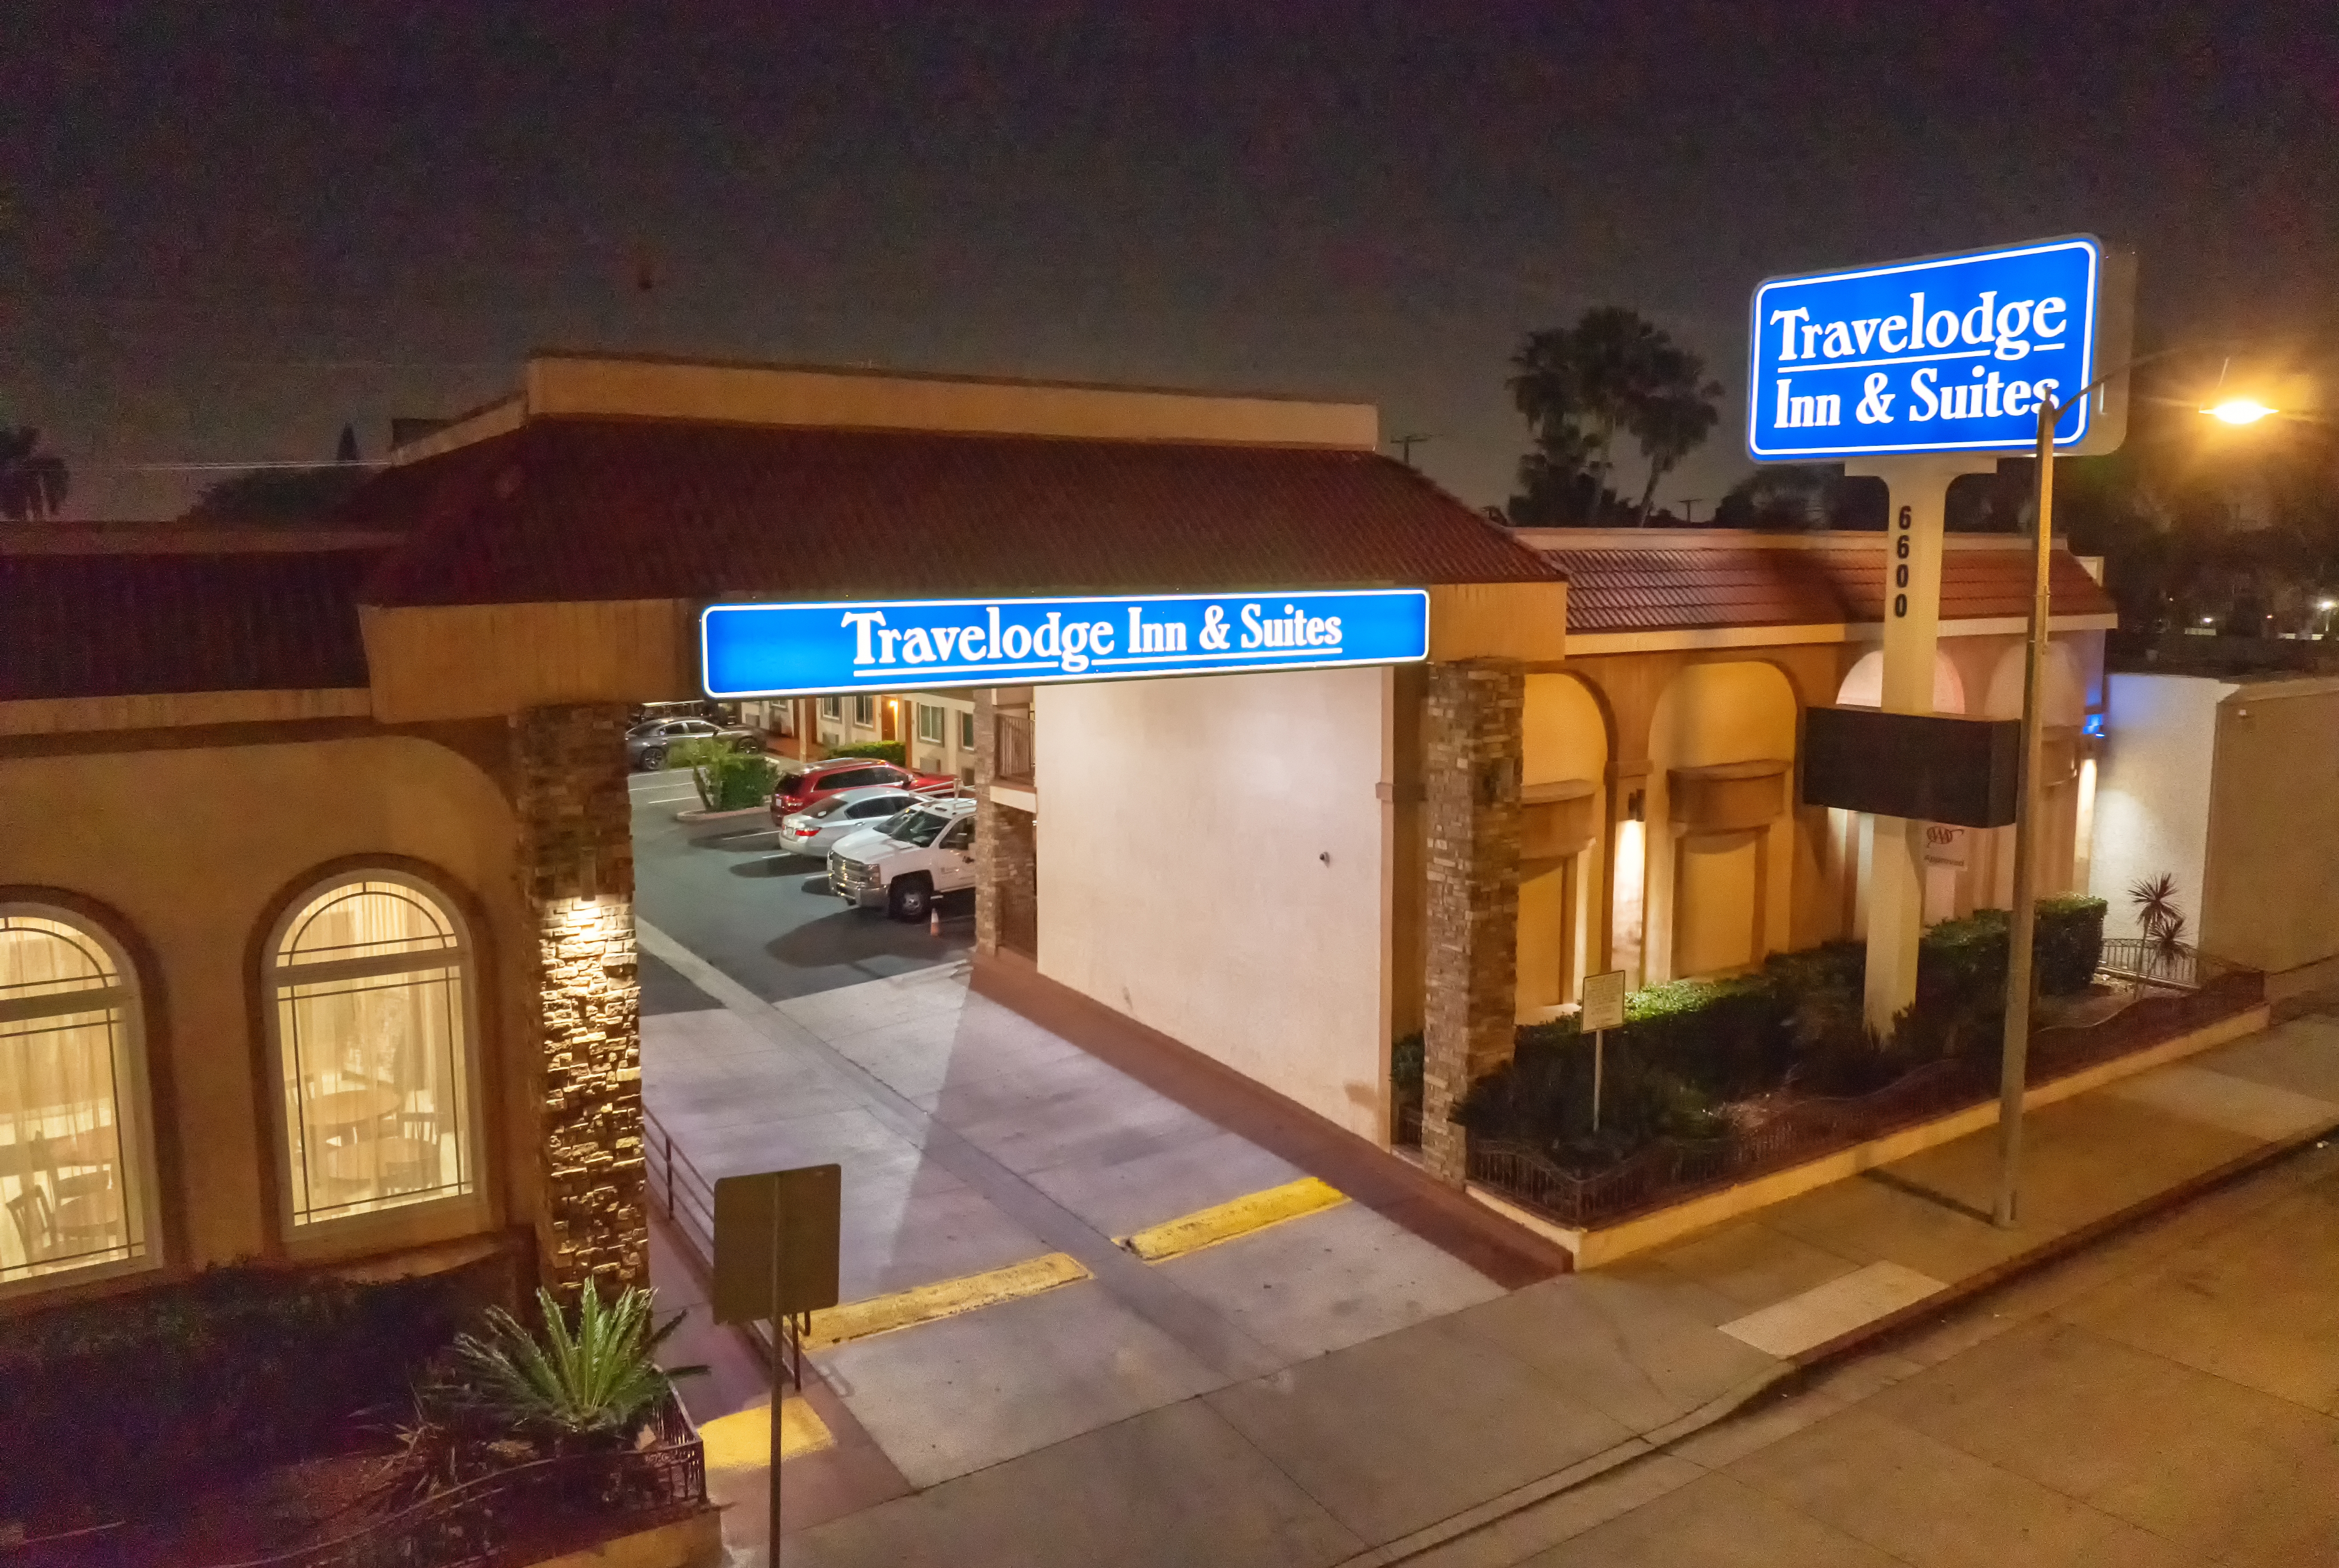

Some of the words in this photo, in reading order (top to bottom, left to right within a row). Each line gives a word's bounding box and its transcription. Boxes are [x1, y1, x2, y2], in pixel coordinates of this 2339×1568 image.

[1770, 290, 2067, 361] Travelodge
[1774, 378, 1841, 428] Inn
[1855, 372, 1896, 425] &
[1909, 365, 2059, 422] Suites
[1894, 505, 1912, 618] 6600
[841, 606, 1115, 672] Travelodge
[1128, 607, 1187, 653] Inn
[1199, 605, 1231, 650] &
[1241, 603, 1342, 649] Suites
